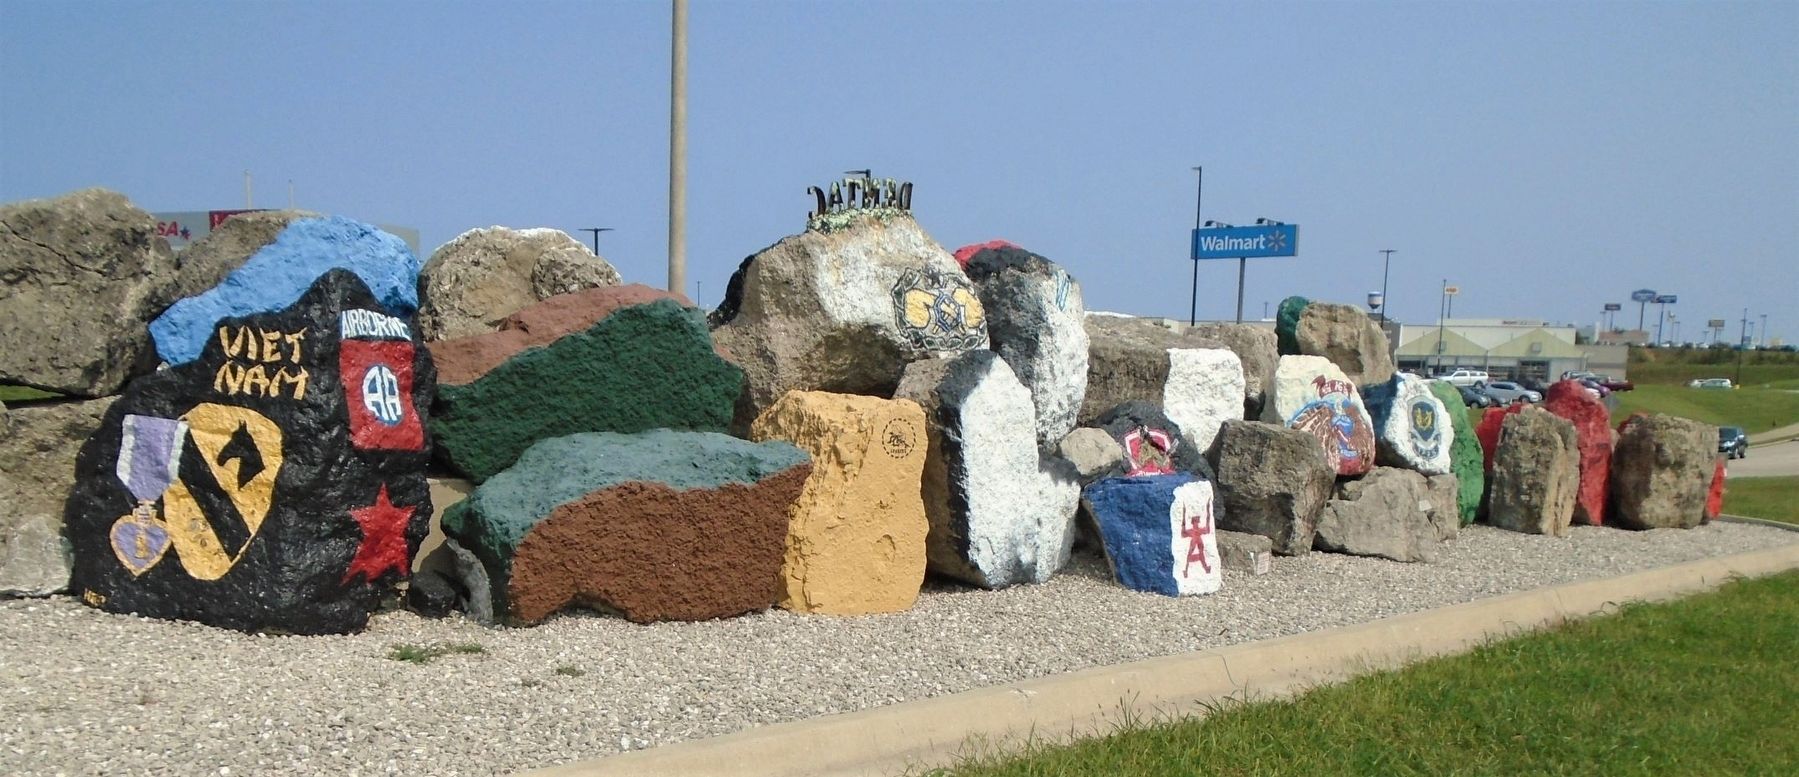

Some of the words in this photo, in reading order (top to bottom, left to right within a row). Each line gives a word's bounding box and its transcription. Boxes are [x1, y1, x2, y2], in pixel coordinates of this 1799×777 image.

[1200, 234, 1266, 251] Walmart
[341, 308, 412, 341] AIRBORNE
[219, 325, 307, 364] VIET
[214, 360, 309, 400] NAM
[362, 365, 402, 421] AA
